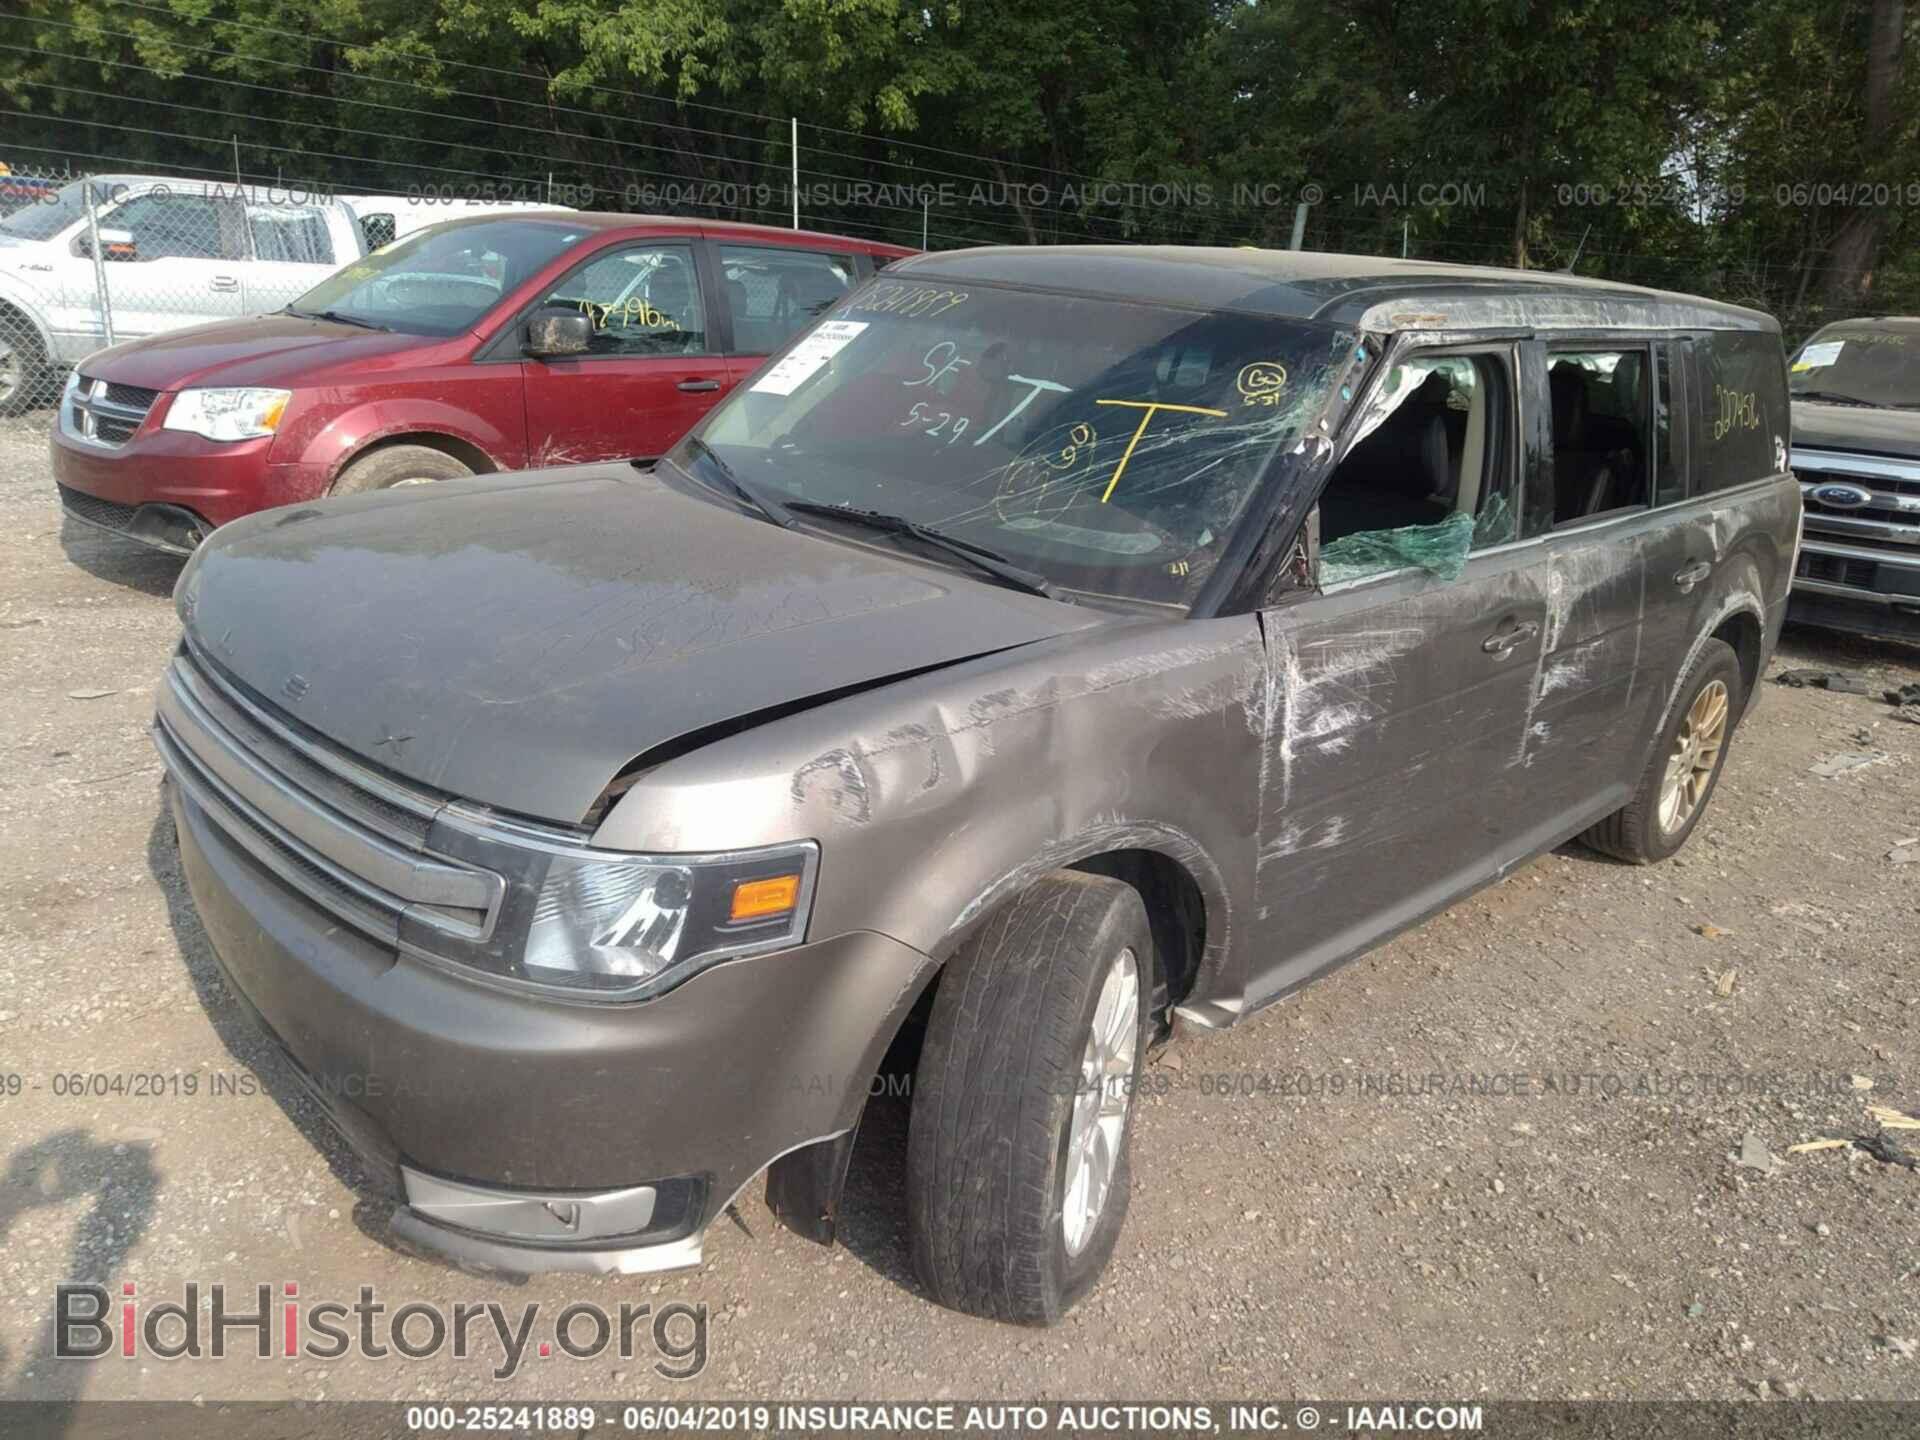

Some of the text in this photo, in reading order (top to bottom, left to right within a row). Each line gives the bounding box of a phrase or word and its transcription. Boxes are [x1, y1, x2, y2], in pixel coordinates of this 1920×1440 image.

[900, 402, 970, 445] 5-29
[973, 374, 1074, 446] T
[1096, 399, 1230, 503] T
